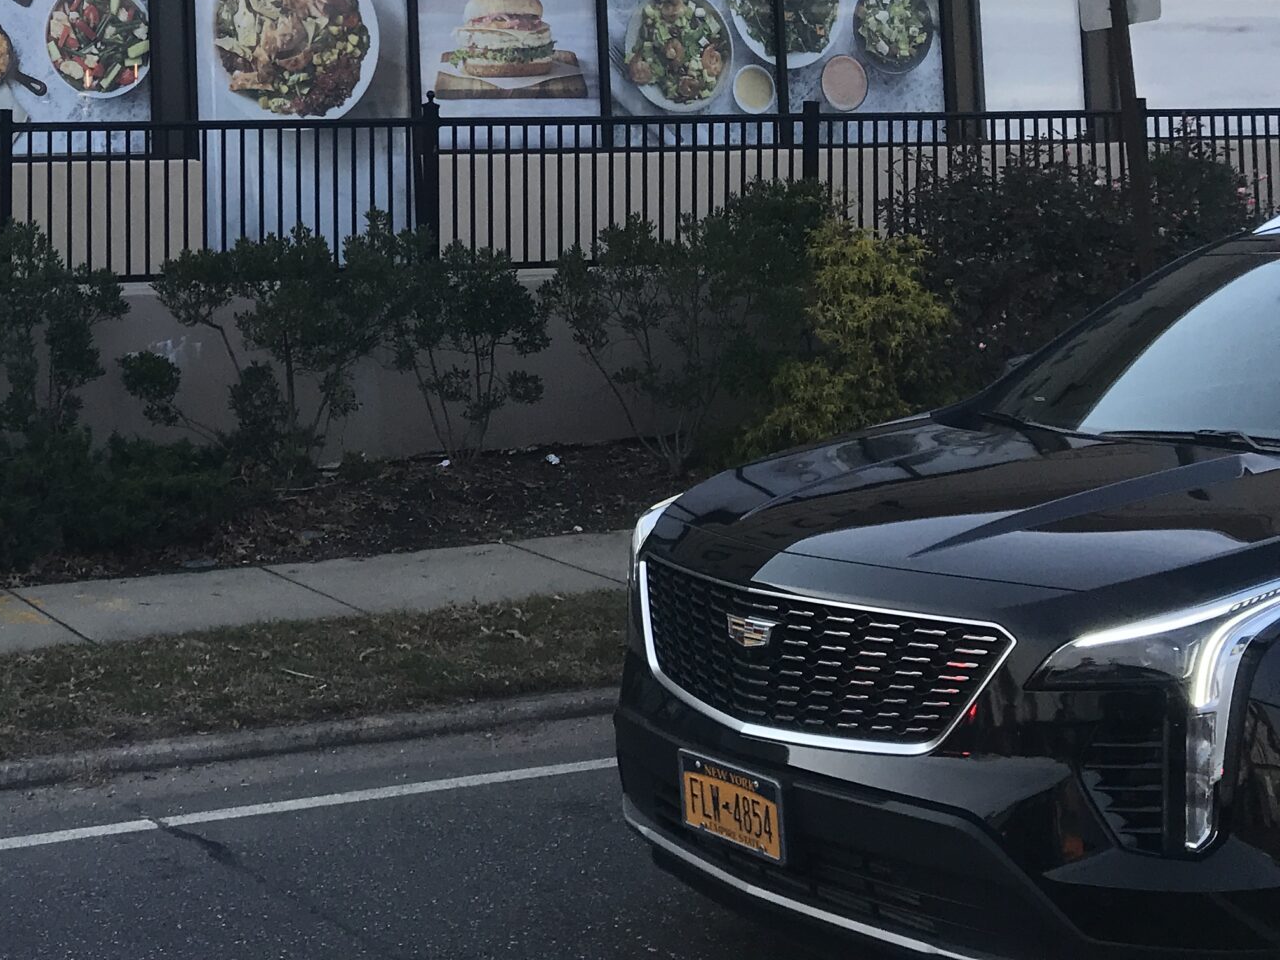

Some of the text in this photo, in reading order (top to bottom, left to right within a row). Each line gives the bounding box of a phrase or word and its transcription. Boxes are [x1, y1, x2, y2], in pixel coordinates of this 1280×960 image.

[704, 765, 755, 791] NEW YORK
[734, 793, 773, 844] 4854
